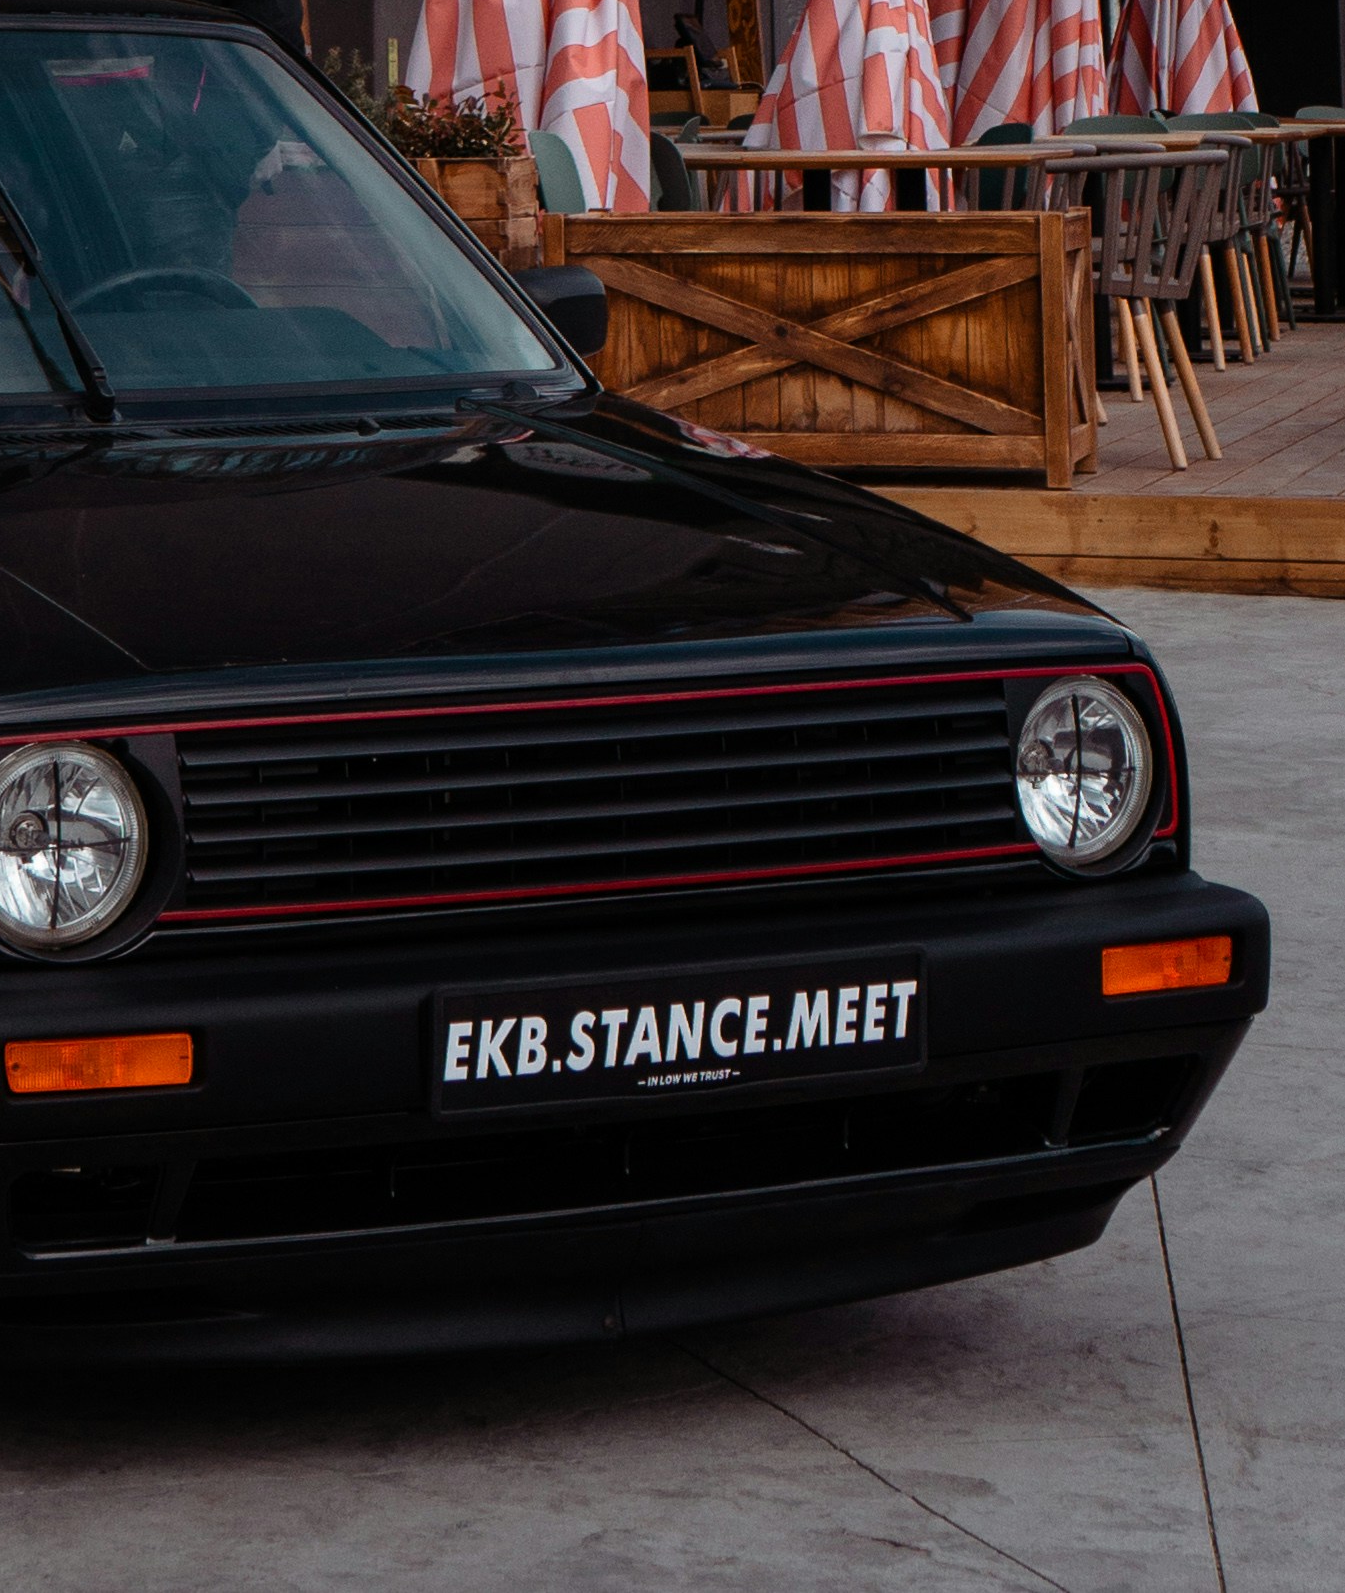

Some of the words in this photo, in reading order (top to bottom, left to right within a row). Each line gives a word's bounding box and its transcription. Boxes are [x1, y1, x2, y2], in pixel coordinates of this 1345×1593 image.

[444, 981, 917, 1081] EKB.STANCE.MEET
[648, 1076, 658, 1086] IN
[683, 1072, 697, 1082] WE
[700, 1069, 731, 1081] TRUST
